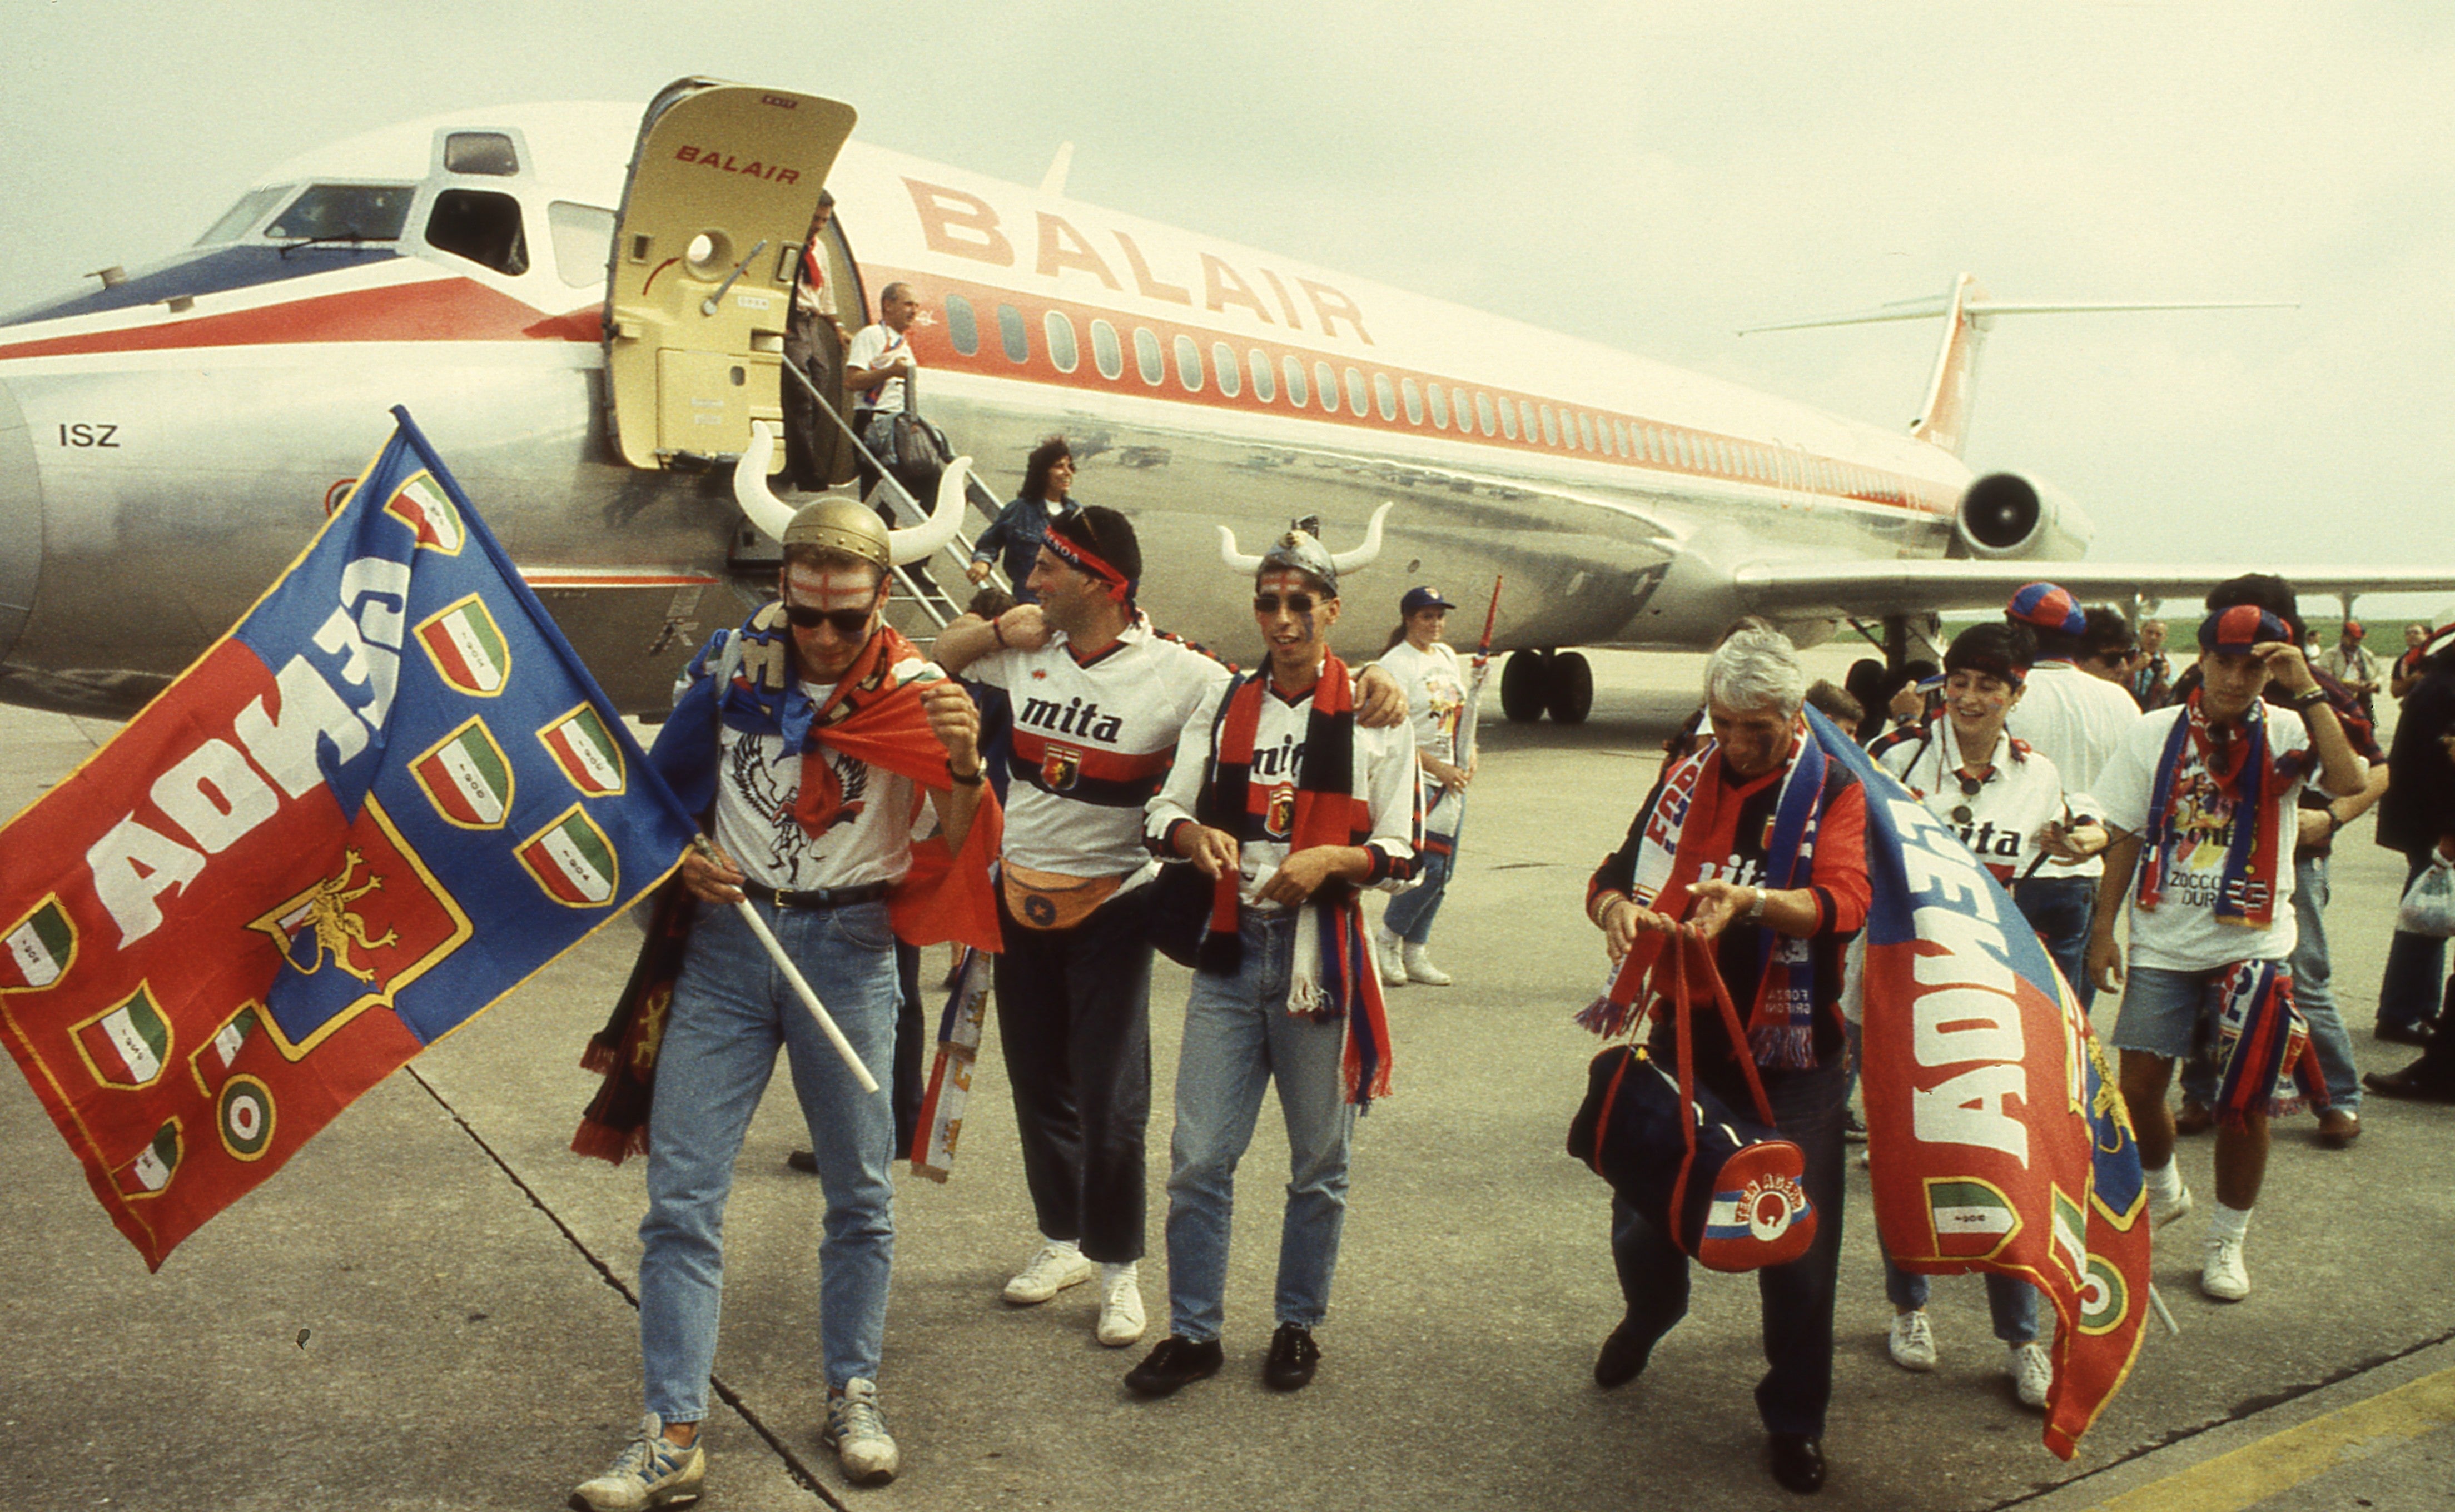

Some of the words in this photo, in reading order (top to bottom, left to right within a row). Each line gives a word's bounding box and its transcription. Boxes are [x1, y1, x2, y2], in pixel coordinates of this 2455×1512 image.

[676, 145, 801, 185] BALAIR
[901, 176, 1375, 346] BALAIR
[59, 423, 120, 448] ISZ
[1018, 696, 1123, 743] mita
[1252, 733, 1305, 777] mit
[1947, 821, 2021, 857] ita
[2170, 871, 2223, 891] ZOCCO
[2181, 889, 2218, 907] DUR
